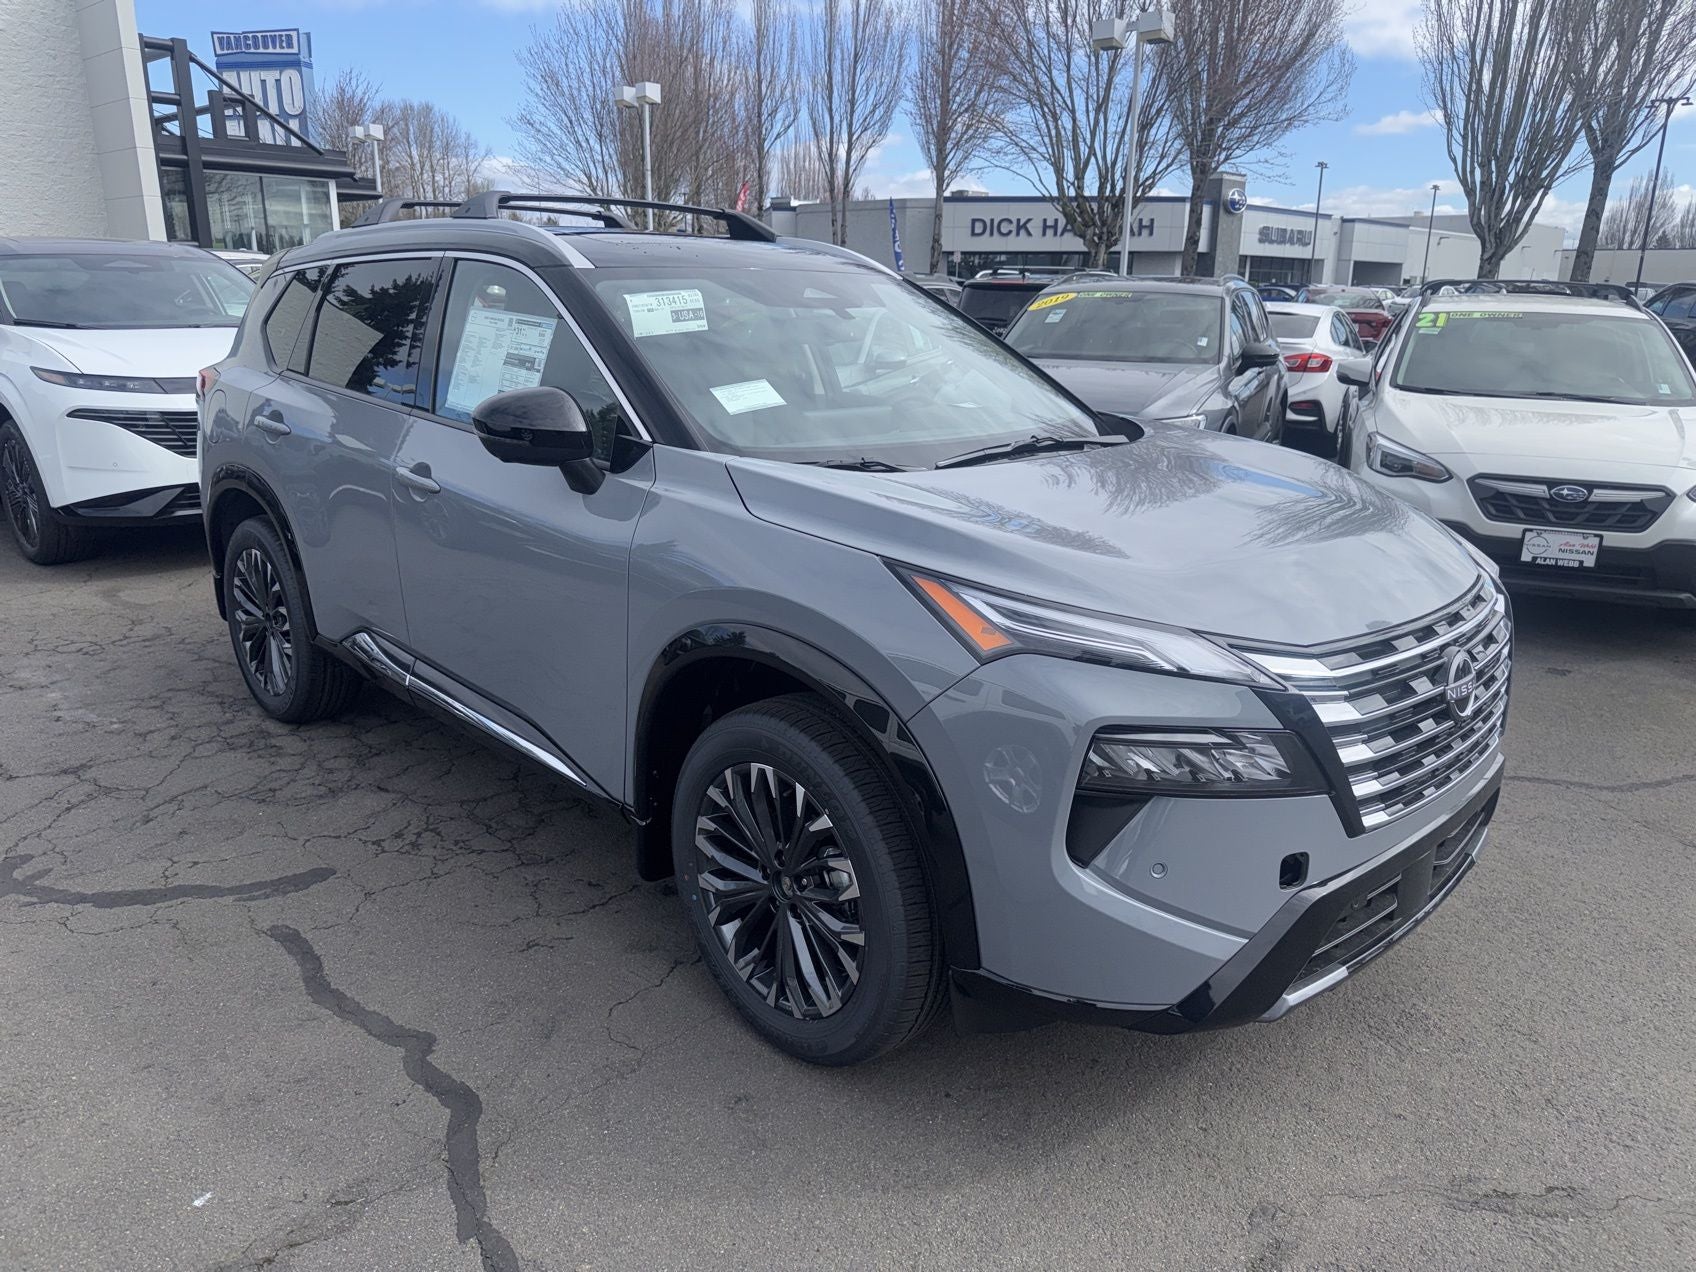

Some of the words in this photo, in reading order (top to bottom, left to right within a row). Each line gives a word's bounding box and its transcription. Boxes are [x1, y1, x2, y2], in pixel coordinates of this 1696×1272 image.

[216, 33, 295, 52] VANCOUVER
[970, 217, 1034, 238] DICK
[1258, 225, 1313, 248] SUBARU
[654, 294, 689, 308] 313415
[1416, 312, 1448, 328] 21
[1558, 547, 1595, 557] NISSAN
[1535, 556, 1556, 566] ALAN
